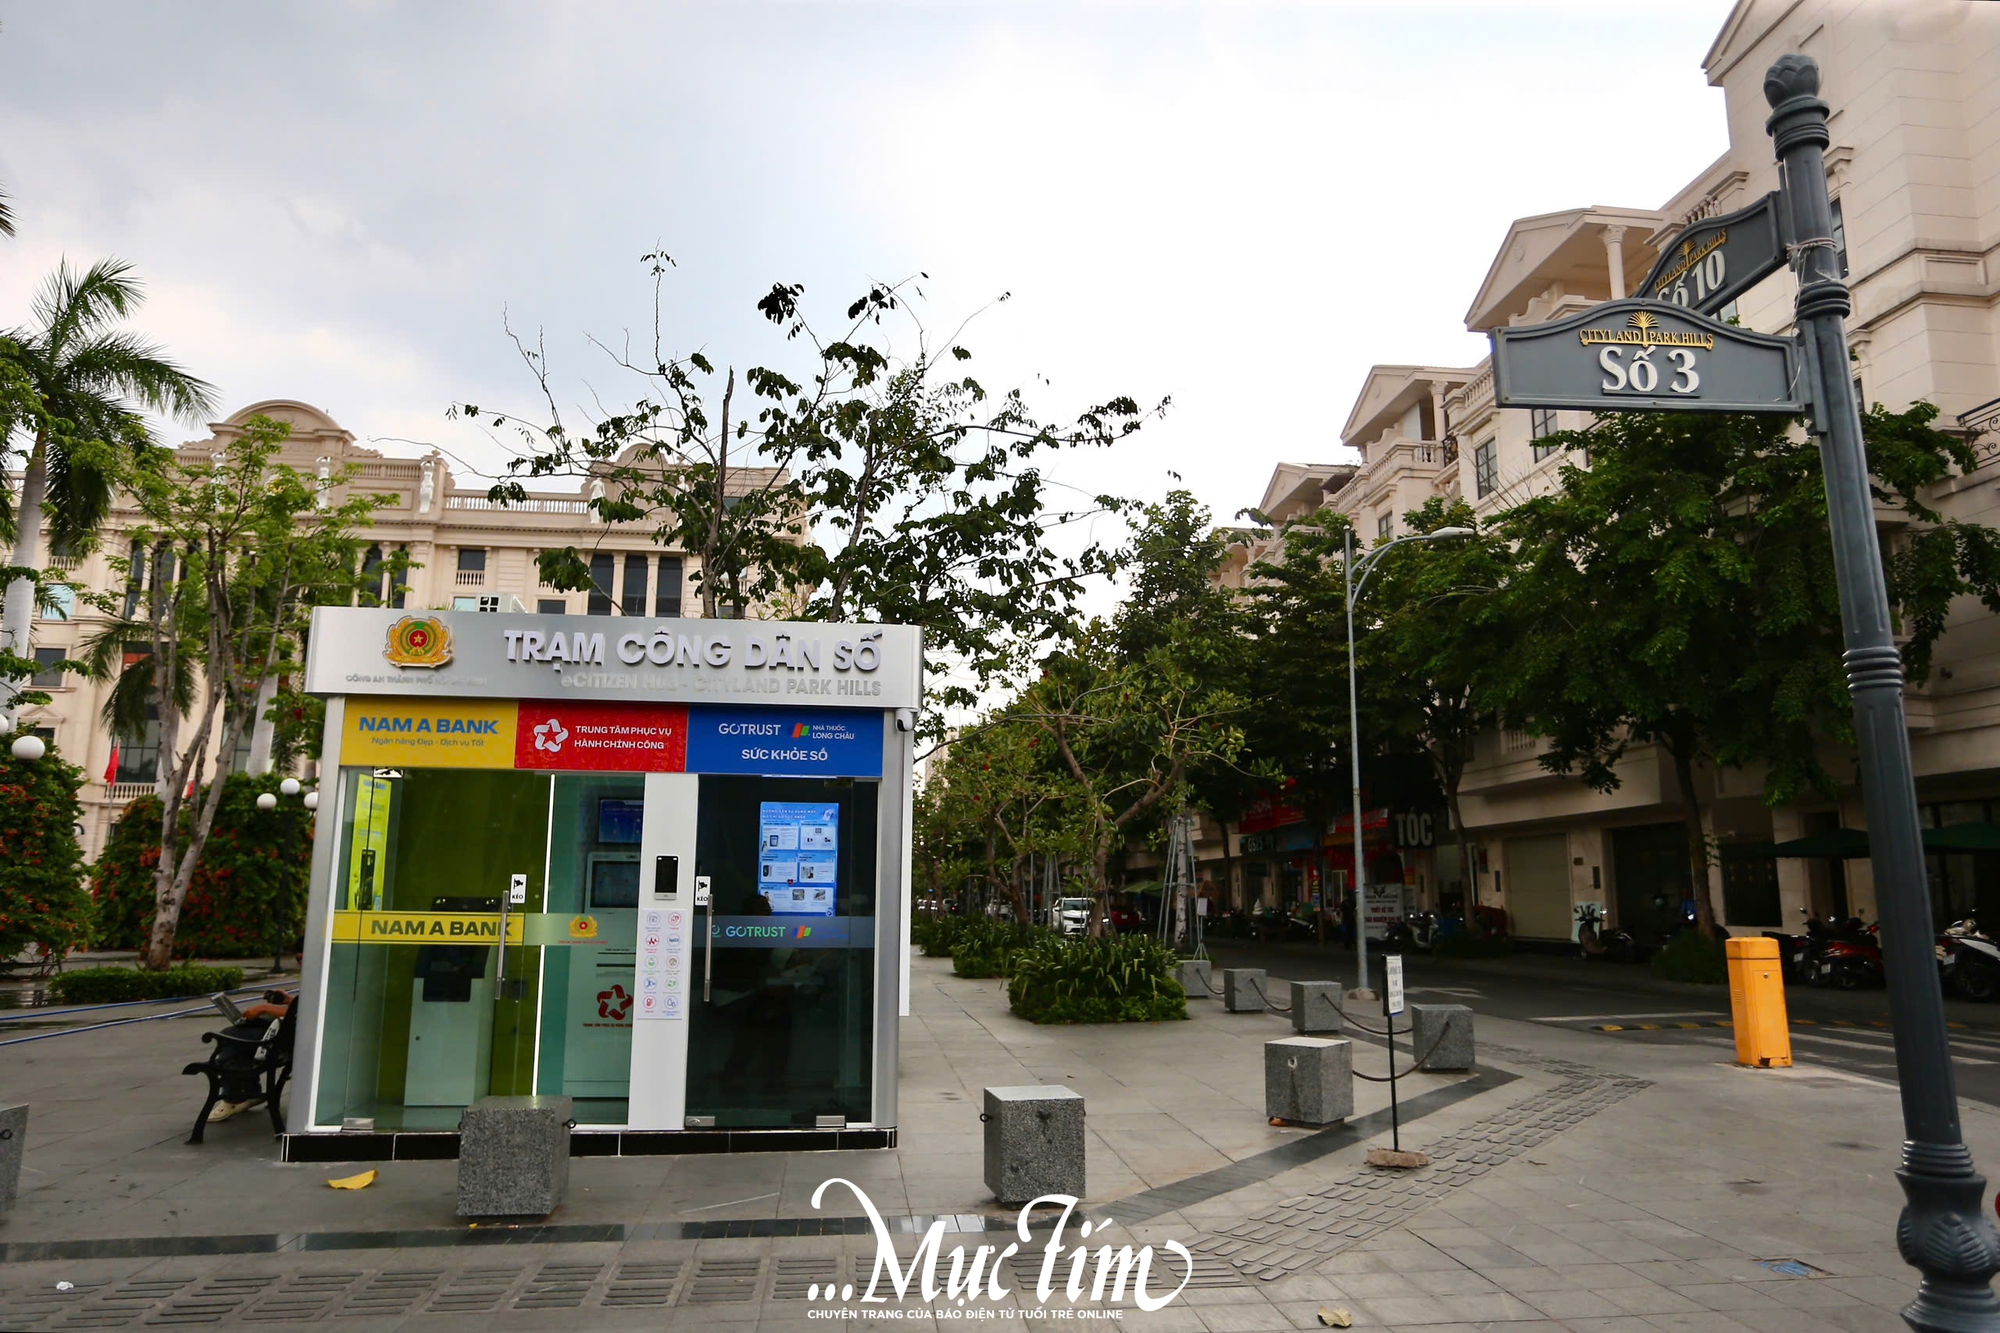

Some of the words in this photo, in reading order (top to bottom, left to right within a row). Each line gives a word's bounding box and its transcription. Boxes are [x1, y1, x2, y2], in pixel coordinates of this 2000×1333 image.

[1689, 242, 1707, 264] PARK
[1707, 228, 1727, 249] HILLS
[1691, 250, 1726, 300] 10
[1580, 329, 1640, 341] CITYLAND
[1649, 330, 1677, 343] PARK
[1681, 332, 1713, 345] HILLS
[1600, 345, 1658, 392] Số
[1667, 349, 1700, 393] 3
[504, 629, 605, 673] TRẠM
[617, 626, 732, 668] CÔNG
[744, 630, 820, 671] DÂN
[833, 628, 883, 671] SỐ
[346, 673, 372, 683] CÔNG
[373, 675, 385, 683] AN
[561, 673, 638, 690] eCITIZEN
[643, 674, 679, 691] HUB
[695, 675, 780, 694] CITYLAND
[787, 678, 832, 695] PARK
[837, 679, 882, 696] HILLS
[359, 716, 412, 732] NAM
[416, 718, 431, 733] A
[436, 719, 499, 735] BANK
[575, 725, 608, 734] TRUNG
[609, 725, 630, 735] TÂM
[630, 726, 657, 736] PHỤC
[658, 727, 672, 736] VỤ
[718, 723, 781, 736] GOTRUST
[372, 737, 395, 746] Ngân
[395, 737, 415, 746] hàng
[417, 738, 433, 747] Đẹp
[440, 738, 459, 747] Dịch
[471, 738, 485, 746] Tốt
[574, 738, 602, 748] HÀNH
[603, 738, 636, 749] CHÍNH
[637, 739, 665, 749] CÔNG
[741, 746, 769, 760] SỨC
[771, 746, 807, 760] KHỎE
[809, 747, 828, 761] SỐ
[1395, 806, 1433, 847] TÓC
[371, 920, 425, 935] NAM
[429, 920, 444, 935] A
[450, 921, 512, 936] BANK
[725, 926, 786, 938] GOTRUST
